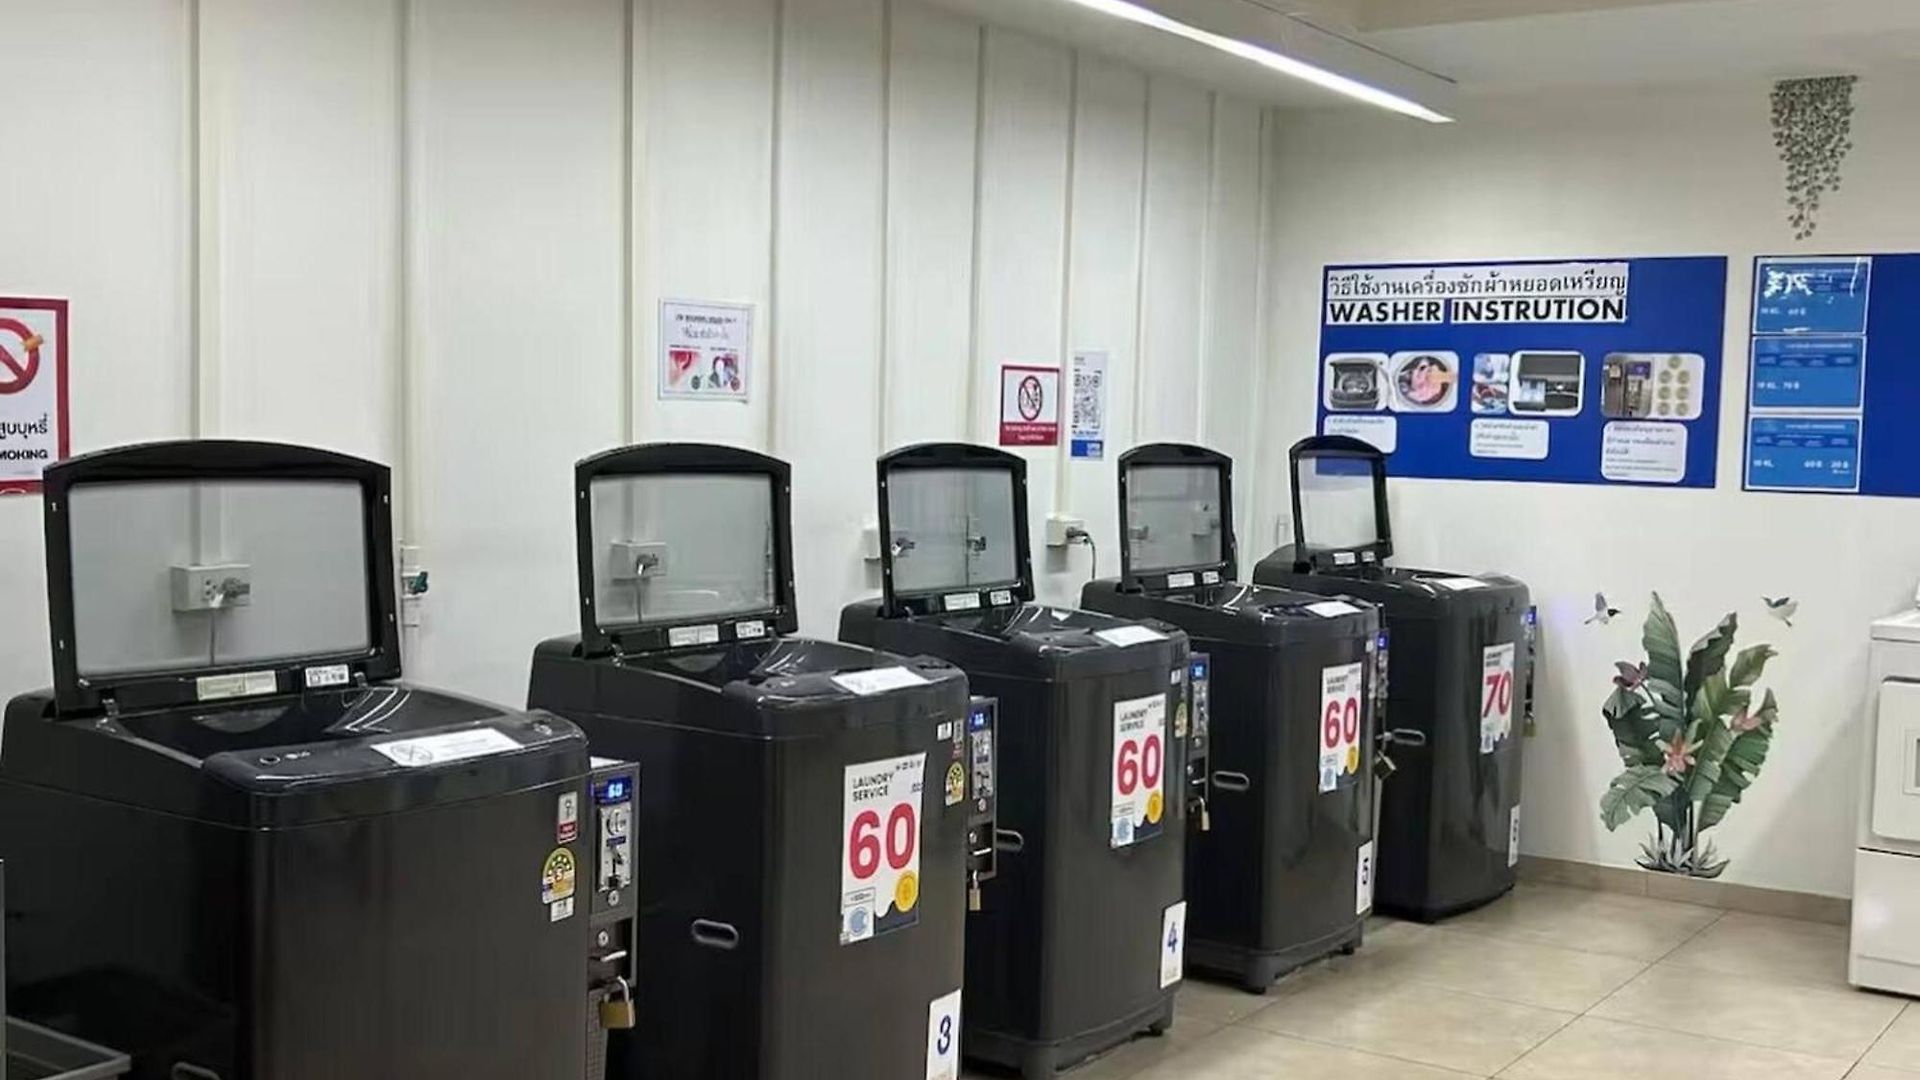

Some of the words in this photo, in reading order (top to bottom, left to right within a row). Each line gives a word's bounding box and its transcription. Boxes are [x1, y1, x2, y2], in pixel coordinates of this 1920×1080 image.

[1329, 268, 1626, 297] วิธีใช้งานเครื่องซักผ้าหยอดเหรียญ
[1329, 301, 1442, 322] WASHER
[1453, 298, 1624, 322] INSTRUTION
[1482, 669, 1512, 718] 70
[1324, 697, 1358, 749] 60
[853, 771, 895, 789] LAUNDRY
[1117, 733, 1161, 796] 60
[853, 784, 889, 802] SERVICE
[849, 803, 916, 880] 60
[1167, 921, 1178, 954] 4
[937, 1014, 952, 1056] 3
